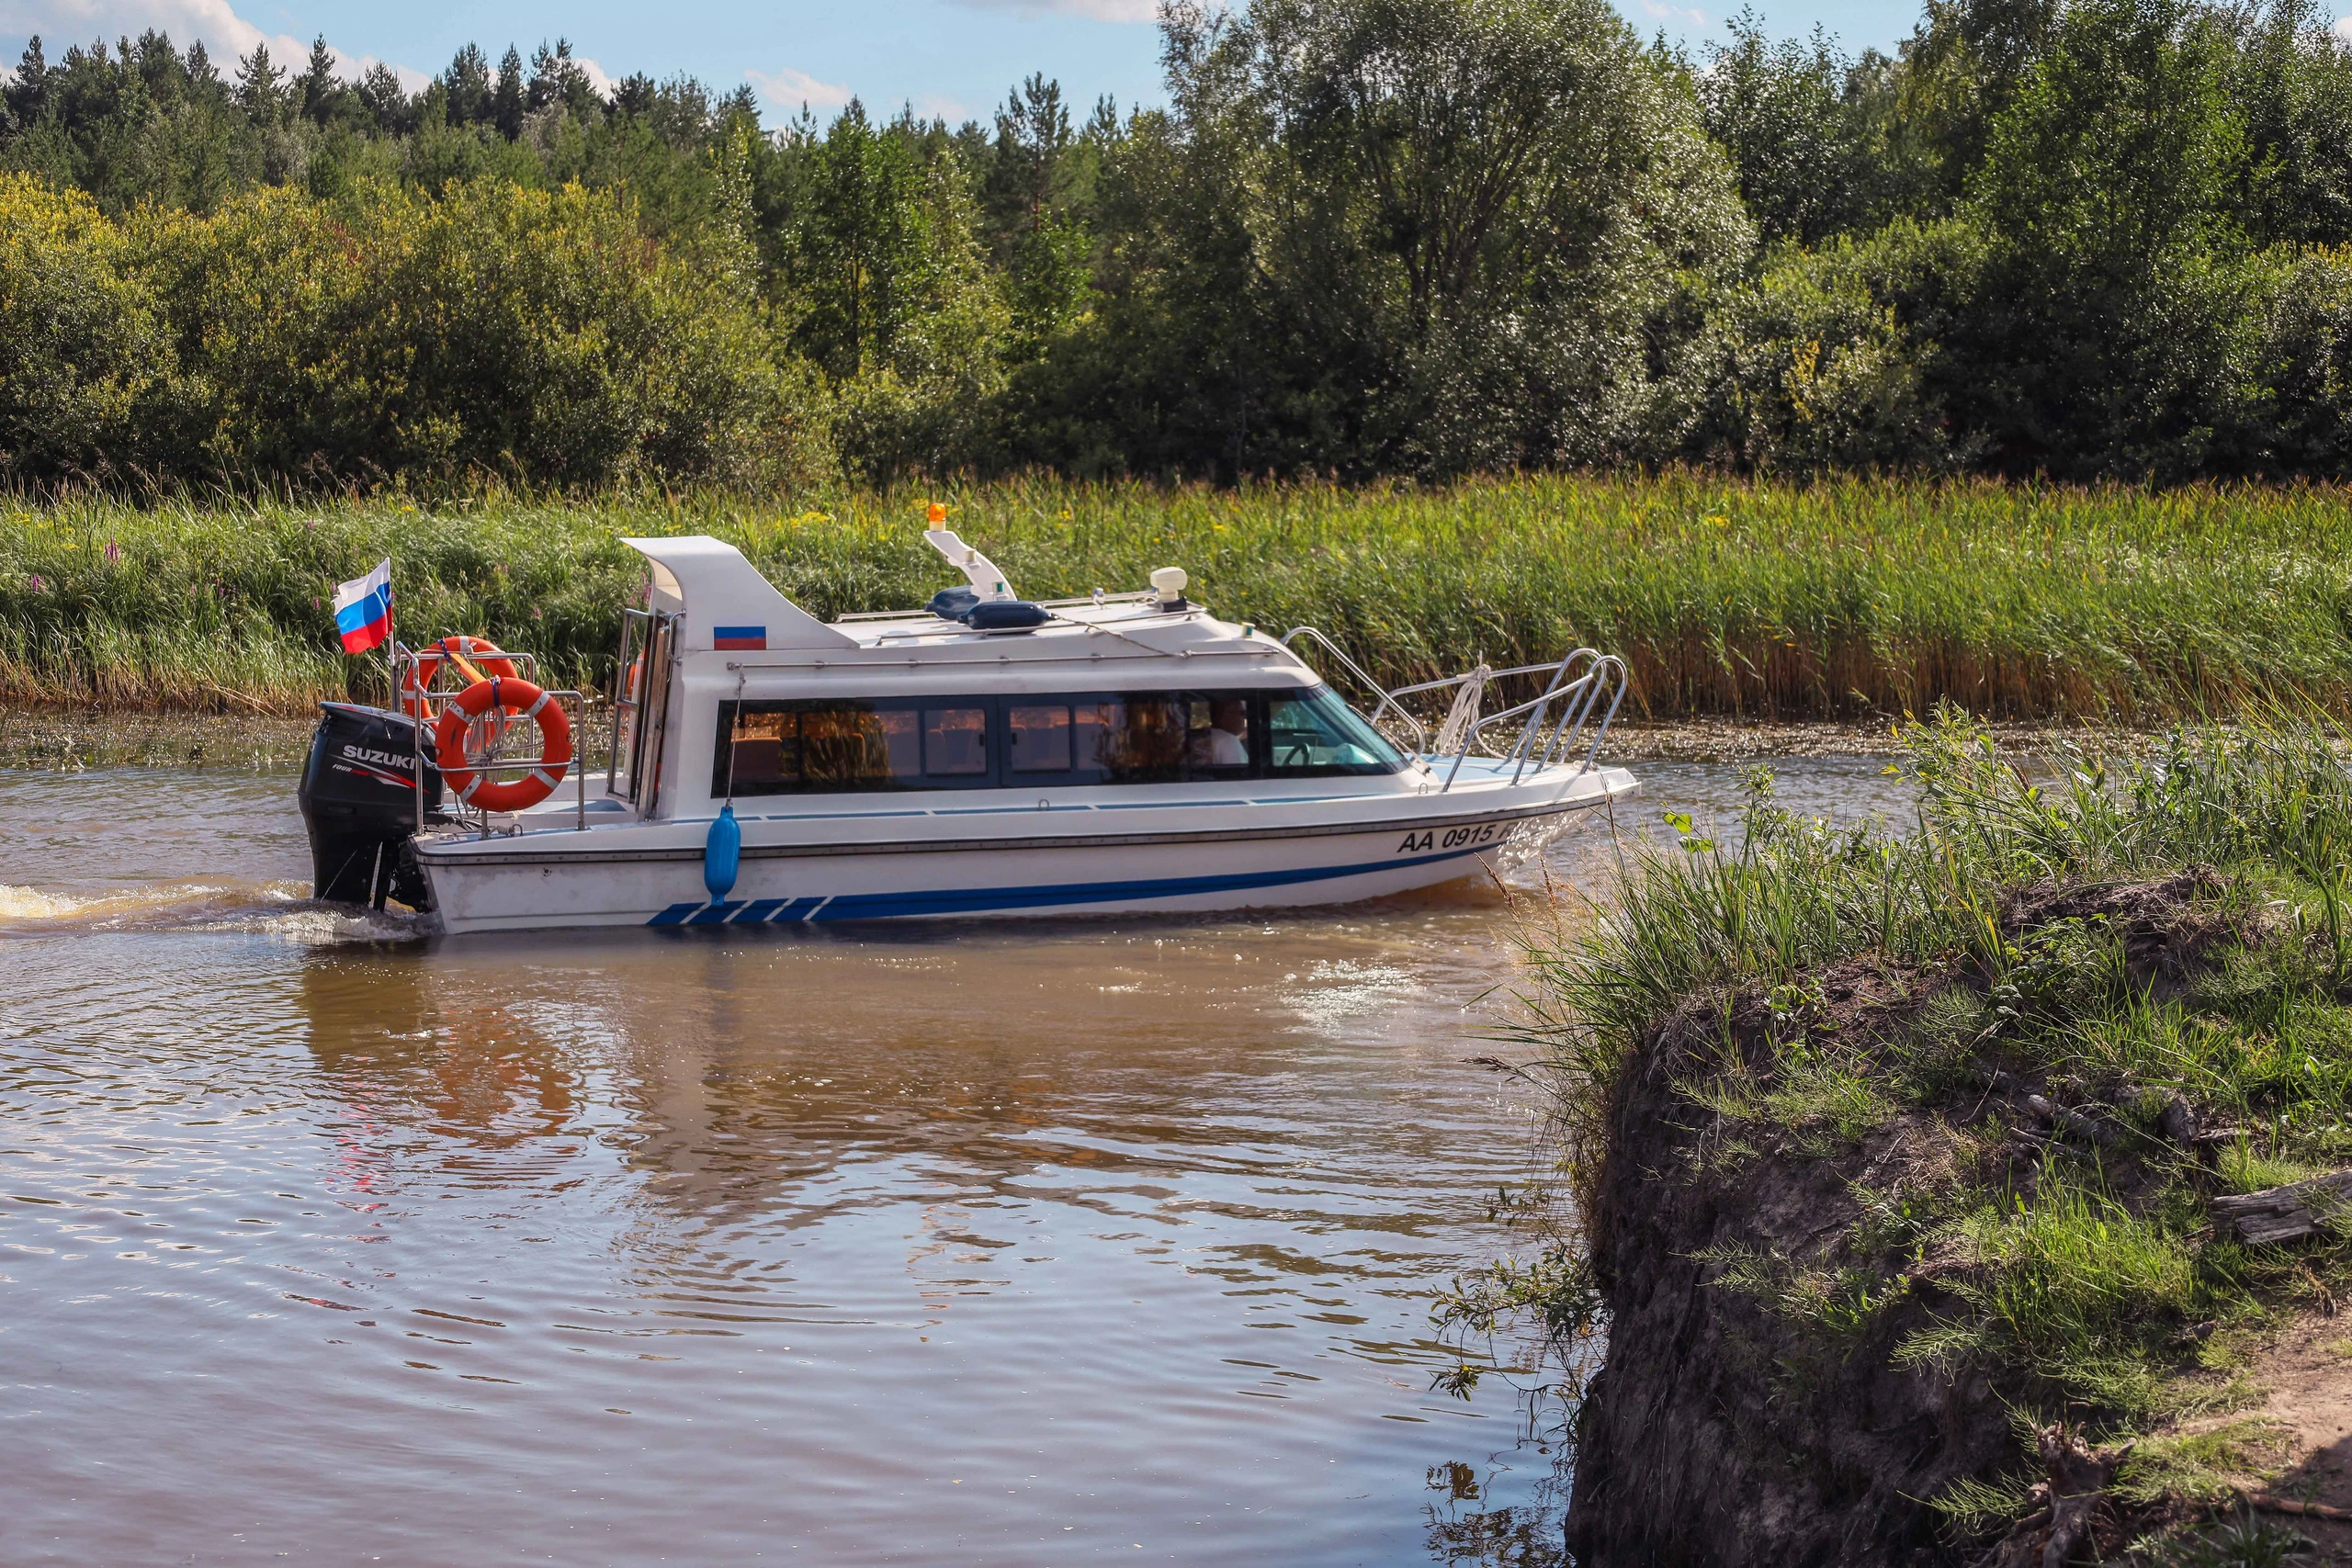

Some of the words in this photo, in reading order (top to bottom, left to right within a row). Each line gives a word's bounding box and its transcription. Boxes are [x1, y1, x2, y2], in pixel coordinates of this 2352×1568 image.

[332, 763, 352, 773] FOUR
[343, 745, 415, 770] SUZUKI
[1396, 831, 1433, 852] AA
[1442, 824, 1497, 848] 0915
